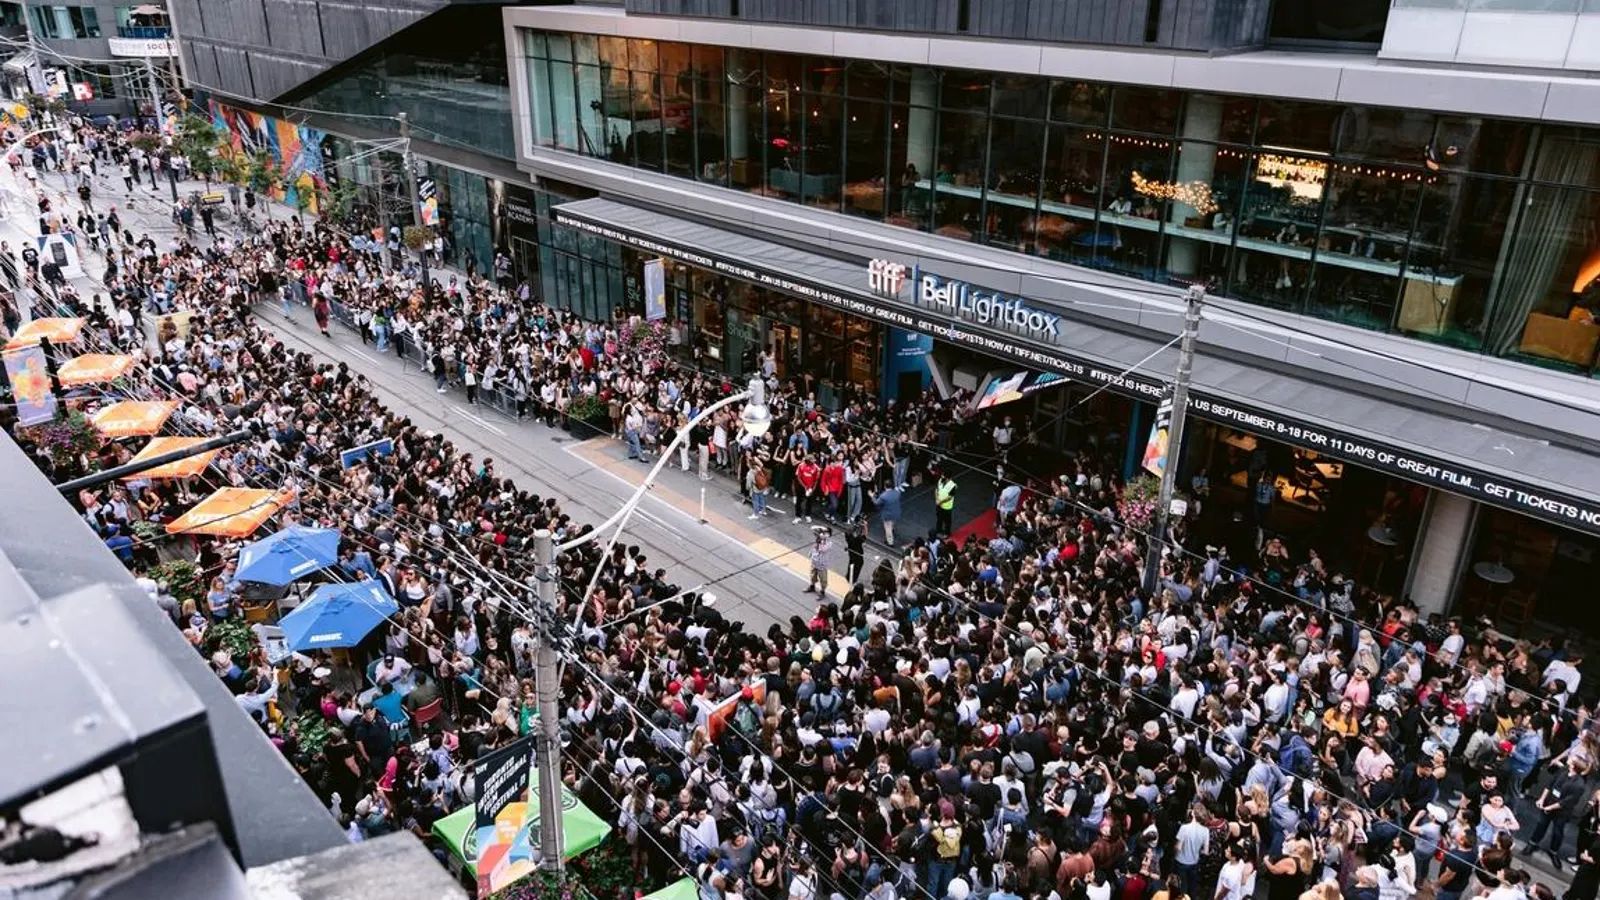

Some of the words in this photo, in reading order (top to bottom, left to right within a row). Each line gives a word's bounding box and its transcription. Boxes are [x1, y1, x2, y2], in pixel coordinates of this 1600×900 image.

[782, 280, 815, 296] SEPTEMBER
[816, 290, 828, 300] 8-18
[829, 294, 842, 305] FOR
[866, 306, 874, 314] OF
[876, 308, 897, 322] GREAT
[918, 320, 933, 332] GET
[985, 338, 1003, 351] NOW
[1004, 345, 1013, 354] AT
[1014, 346, 1084, 374] TIFF.NET/TICKETS
[1090, 370, 1125, 387] #TIFF22
[1125, 380, 1135, 390] IS
[867, 258, 906, 294] tiff
[922, 274, 958, 309] Bell
[961, 284, 1062, 336] Lightbox
[1194, 400, 1210, 412] US
[1211, 404, 1276, 431] SEPTEMBER
[1276, 422, 1301, 438] 8-18
[1302, 427, 1328, 446] FOR
[1330, 438, 1342, 450] 11
[1344, 442, 1376, 460] DAYS
[1377, 452, 1396, 464] OF
[1397, 457, 1440, 478] GREAT
[1484, 482, 1514, 500] GET
[1516, 490, 1578, 518] TICKETS
